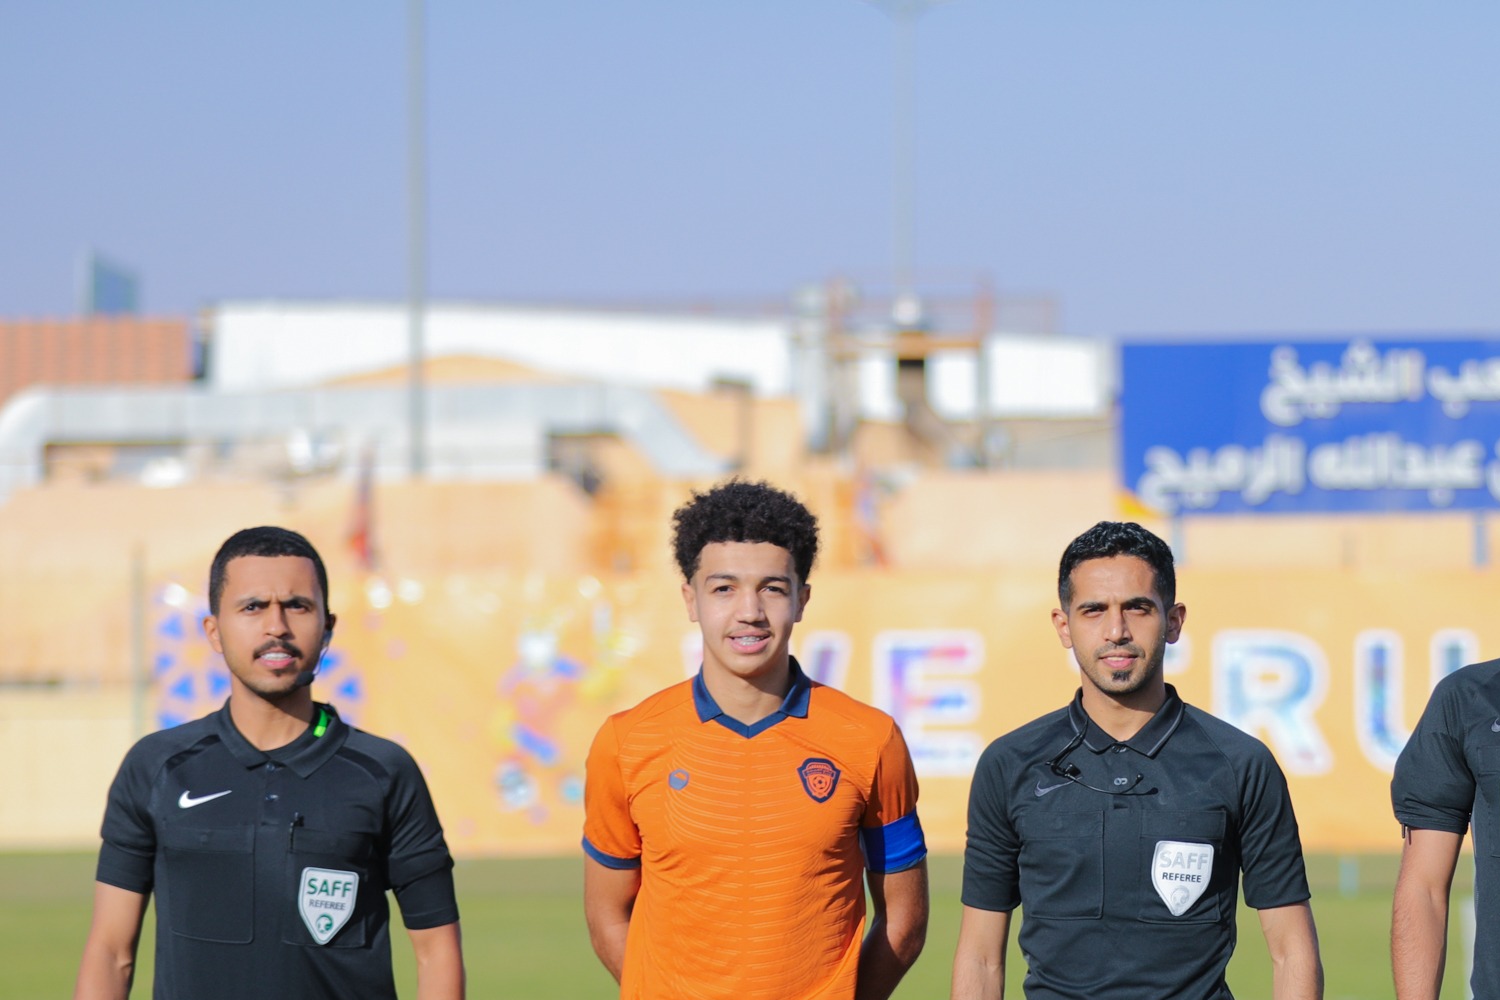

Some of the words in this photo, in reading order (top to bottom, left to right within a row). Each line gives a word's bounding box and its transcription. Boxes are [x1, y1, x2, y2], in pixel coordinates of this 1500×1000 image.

[1259, 336, 1427, 427] الشيخ
[1136, 432, 1307, 516] الرميح
[1309, 430, 1485, 507] عبدالله
[1159, 850, 1209, 870] SAFF
[1162, 872, 1202, 883] REFEREE
[307, 878, 352, 898] SAFF
[309, 899, 346, 911] REFEREE
